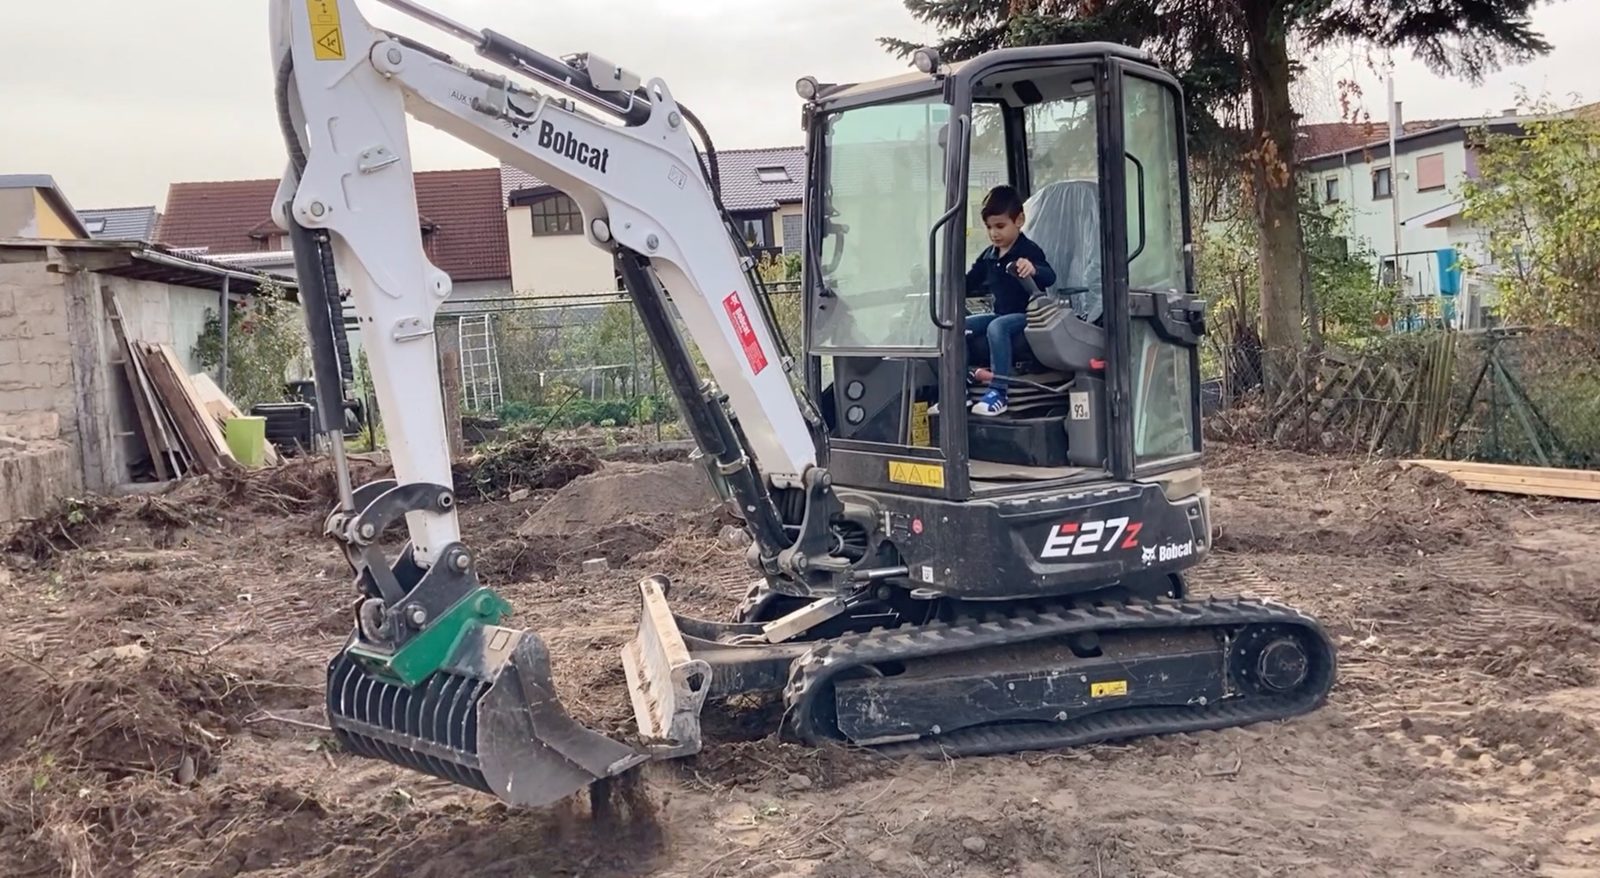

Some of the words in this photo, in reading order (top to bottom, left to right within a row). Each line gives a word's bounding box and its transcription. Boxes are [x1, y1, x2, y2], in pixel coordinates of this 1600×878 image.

[451, 90, 467, 103] AUX
[538, 120, 609, 174] Bobcat
[735, 306, 751, 336] Bobcat
[1074, 403, 1084, 418] 93
[1159, 540, 1192, 562] Bobcat
